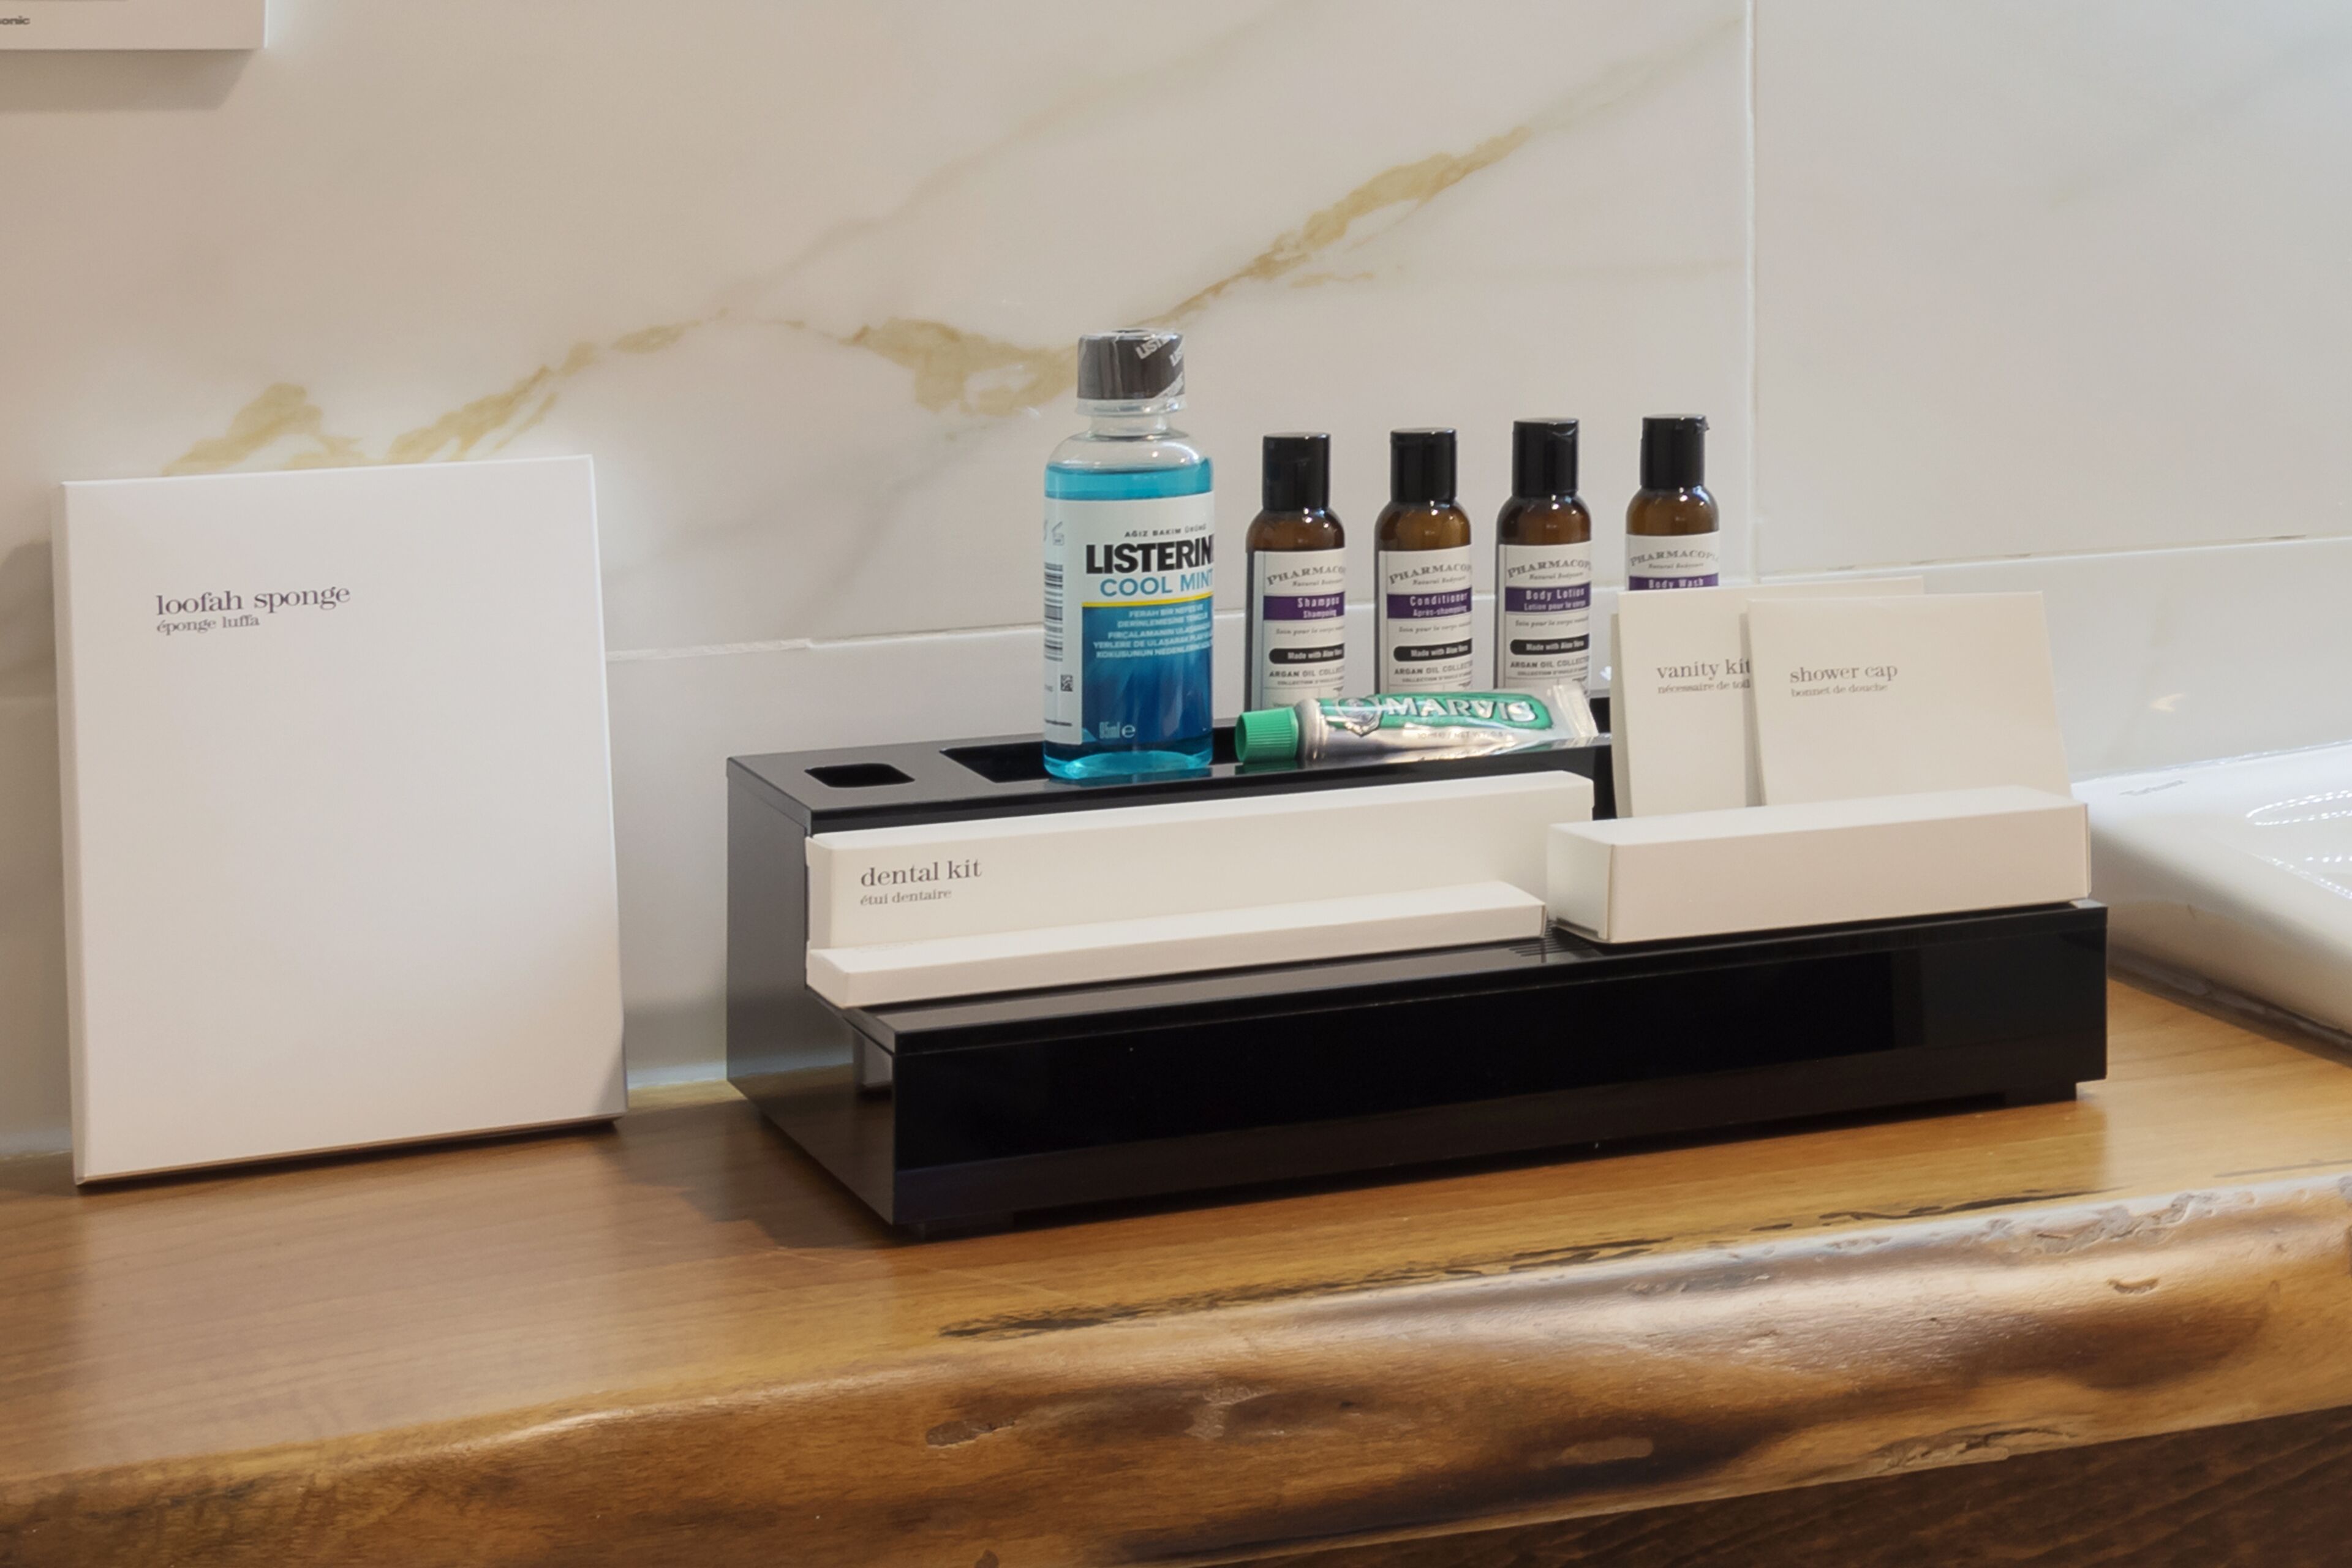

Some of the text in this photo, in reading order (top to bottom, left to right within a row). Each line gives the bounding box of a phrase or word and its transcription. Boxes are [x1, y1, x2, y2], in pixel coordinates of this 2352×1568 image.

[1086, 533, 1214, 574] LISTERIN
[1100, 576, 1172, 597] COOL
[1648, 578, 1704, 589] Body Wash
[156, 586, 350, 616] loofah sponge
[1409, 592, 1468, 606] Conditioner
[1526, 587, 1585, 601] Body Lotion
[157, 614, 260, 636] éponge luffa
[1302, 669, 1316, 677] OIL
[1657, 657, 1751, 681] vanity kit
[1790, 664, 1898, 684] shower cap
[1657, 682, 1714, 694] nécessaire
[1716, 680, 1730, 690] de
[1791, 682, 1888, 698] bonnet de douche
[1384, 696, 1537, 722] MARVIS
[860, 858, 982, 887] dental kit
[860, 889, 952, 907] étui dentaire
